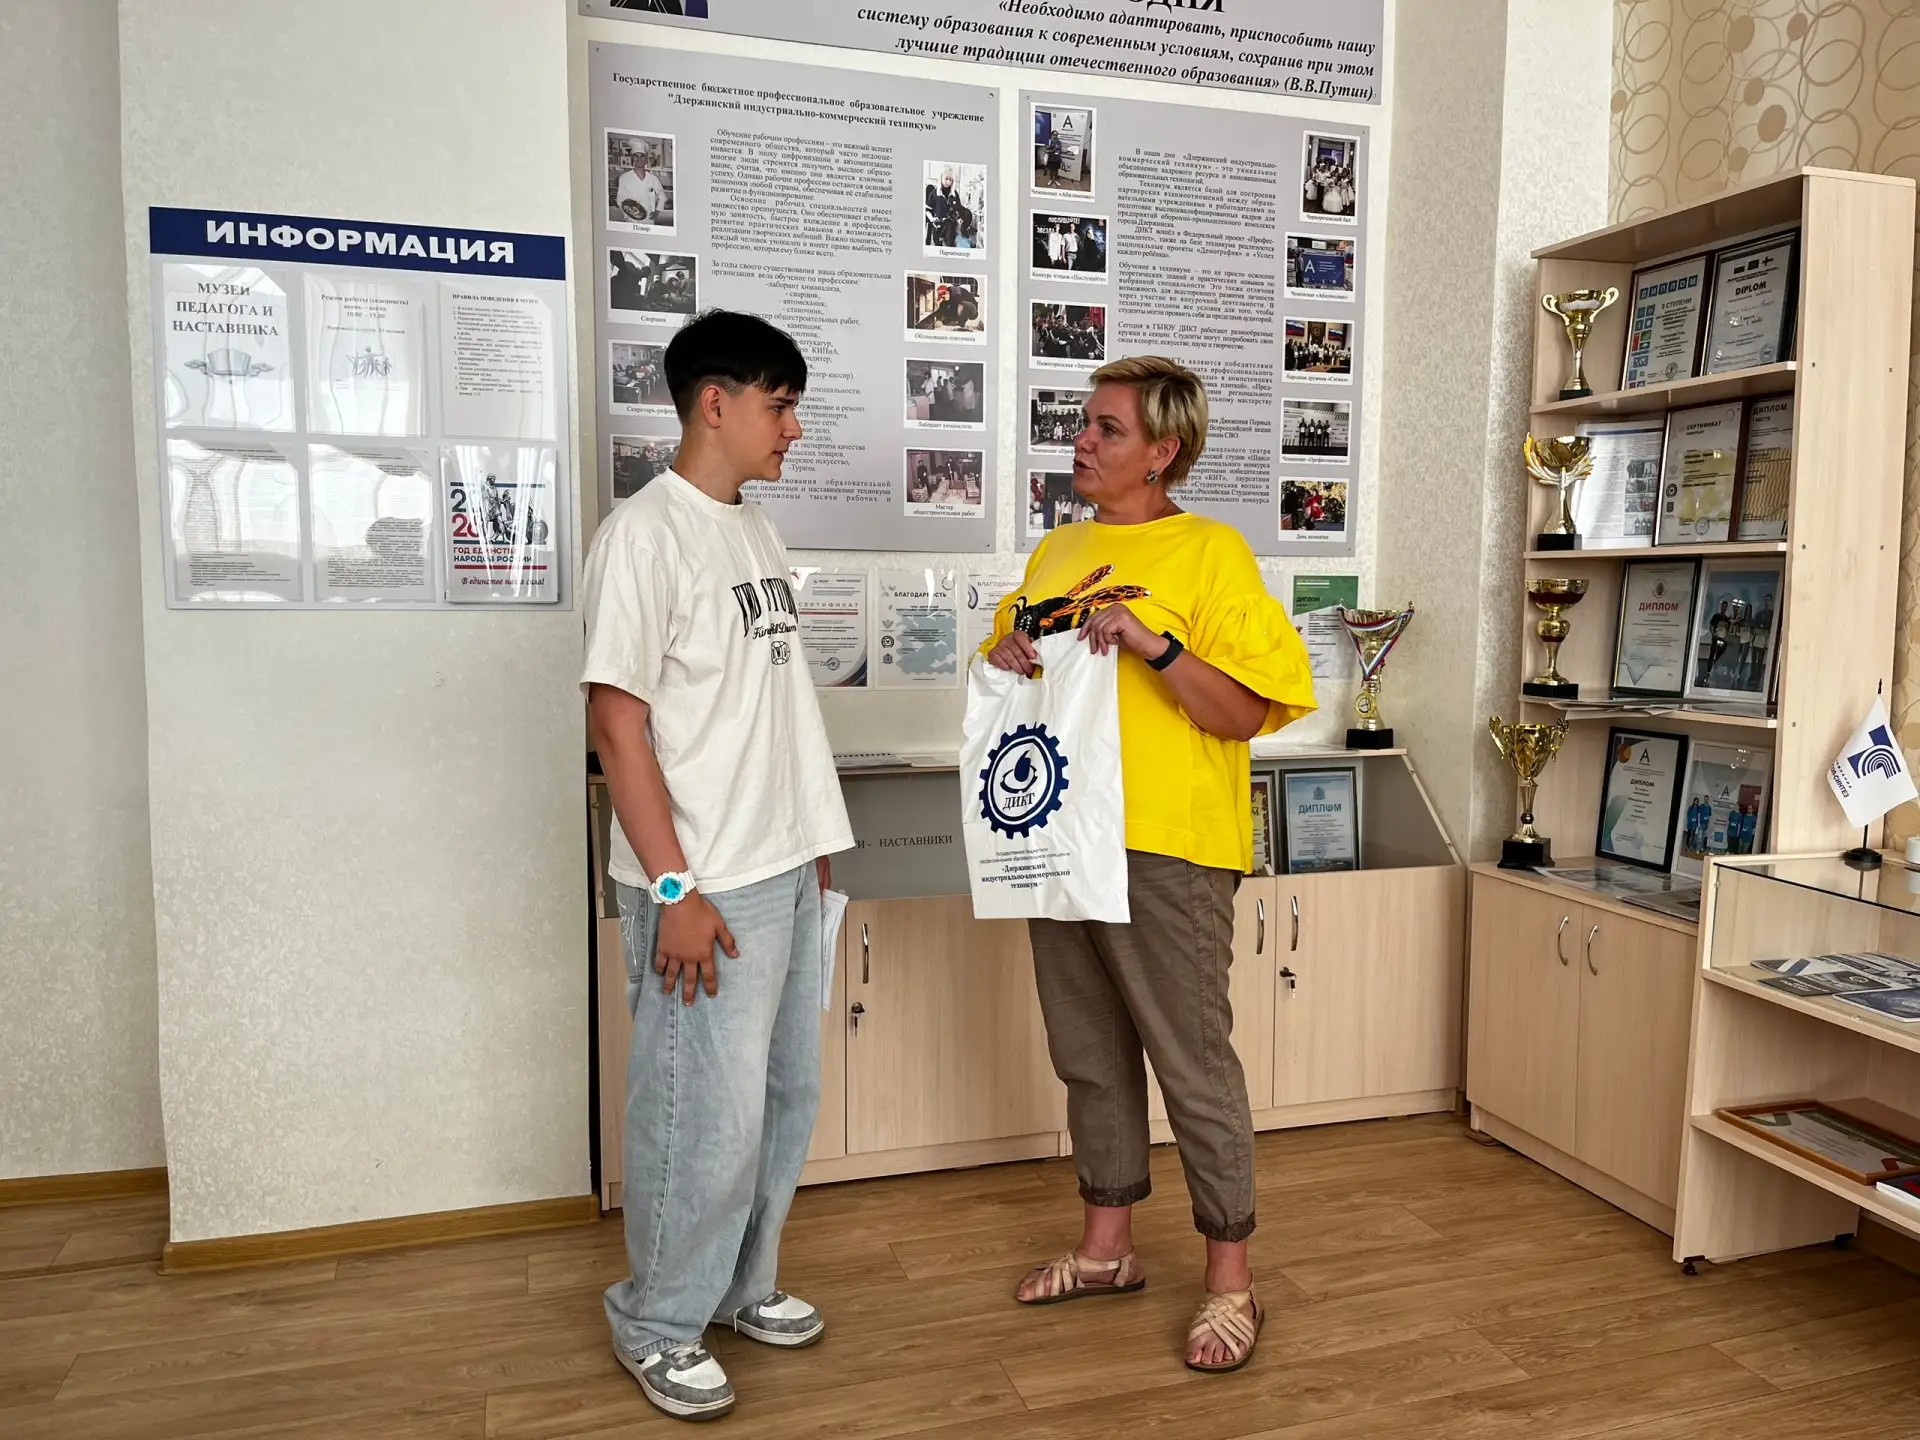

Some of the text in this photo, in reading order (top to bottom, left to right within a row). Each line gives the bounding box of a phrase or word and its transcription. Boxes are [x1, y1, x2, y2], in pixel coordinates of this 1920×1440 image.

[998, 0, 1104, 23] «Необходимо
[1109, 12, 1225, 41] адаптировать,
[1230, 28, 1332, 49] приспособить
[1337, 40, 1374, 58] нашу
[857, 9, 1373, 76] систему образования к современным условиям, сохранив при этом
[895, 38, 1373, 102] лучшие традиции отечественного образования» (В.В.Путин)
[612, 71, 983, 123] Государственное бюджетное профессиональное образовательное учреждение
[743, 103, 885, 126] индустриально-коммерческий
[888, 119, 936, 133] техникум»
[740, 156, 758, 165] люди
[762, 158, 797, 167] стремятся
[801, 162, 833, 171] получить
[837, 165, 863, 173] высшее
[1139, 178, 1170, 190] Техникум
[1204, 185, 1222, 193] базой
[1240, 190, 1275, 199] построения
[730, 194, 766, 204] Освоение
[775, 198, 805, 207] рабочих
[809, 202, 867, 212] специальностей
[207, 220, 514, 264] ИНФОРМАЦИЯ
[711, 259, 719, 267] За
[721, 262, 737, 270] годы
[763, 265, 814, 274] существования
[837, 268, 891, 279] образовательная
[711, 269, 754, 279] организация
[774, 272, 806, 282] обучение
[1118, 260, 1148, 269] Обучение
[1159, 265, 1191, 274] техникуме
[1224, 270, 1245, 278] просто
[1640, 276, 1698, 299] ДИПЛОМ
[1735, 281, 1767, 296] DIPLOM
[176, 301, 273, 316] ПЕДАГОГА И
[172, 320, 278, 336] НАСТАВНИКА
[1173, 331, 1201, 340] Студенты
[1222, 335, 1258, 344] попробовать
[1210, 366, 1273, 375] профессионального
[1224, 359, 1273, 369] победителями
[1237, 397, 1272, 406] мастерству
[1752, 403, 1787, 416] ДИПЛОМ
[1686, 420, 1722, 430] СЕРТИФИКАТ
[825, 477, 890, 487] образовательной
[857, 488, 890, 496] техникума
[1180, 493, 1239, 502] Межрегионального
[461, 577, 468, 585] В
[1638, 601, 1679, 612] ДИПЛОМ
[1630, 778, 1655, 788] ДИПЛОМ
[1002, 792, 1036, 811] ДИКТ
[1298, 803, 1342, 815] ДИПЛОМ
[879, 835, 953, 847] НАСТАВНИКИ
[981, 869, 1071, 883] индустриально-коммерческий
